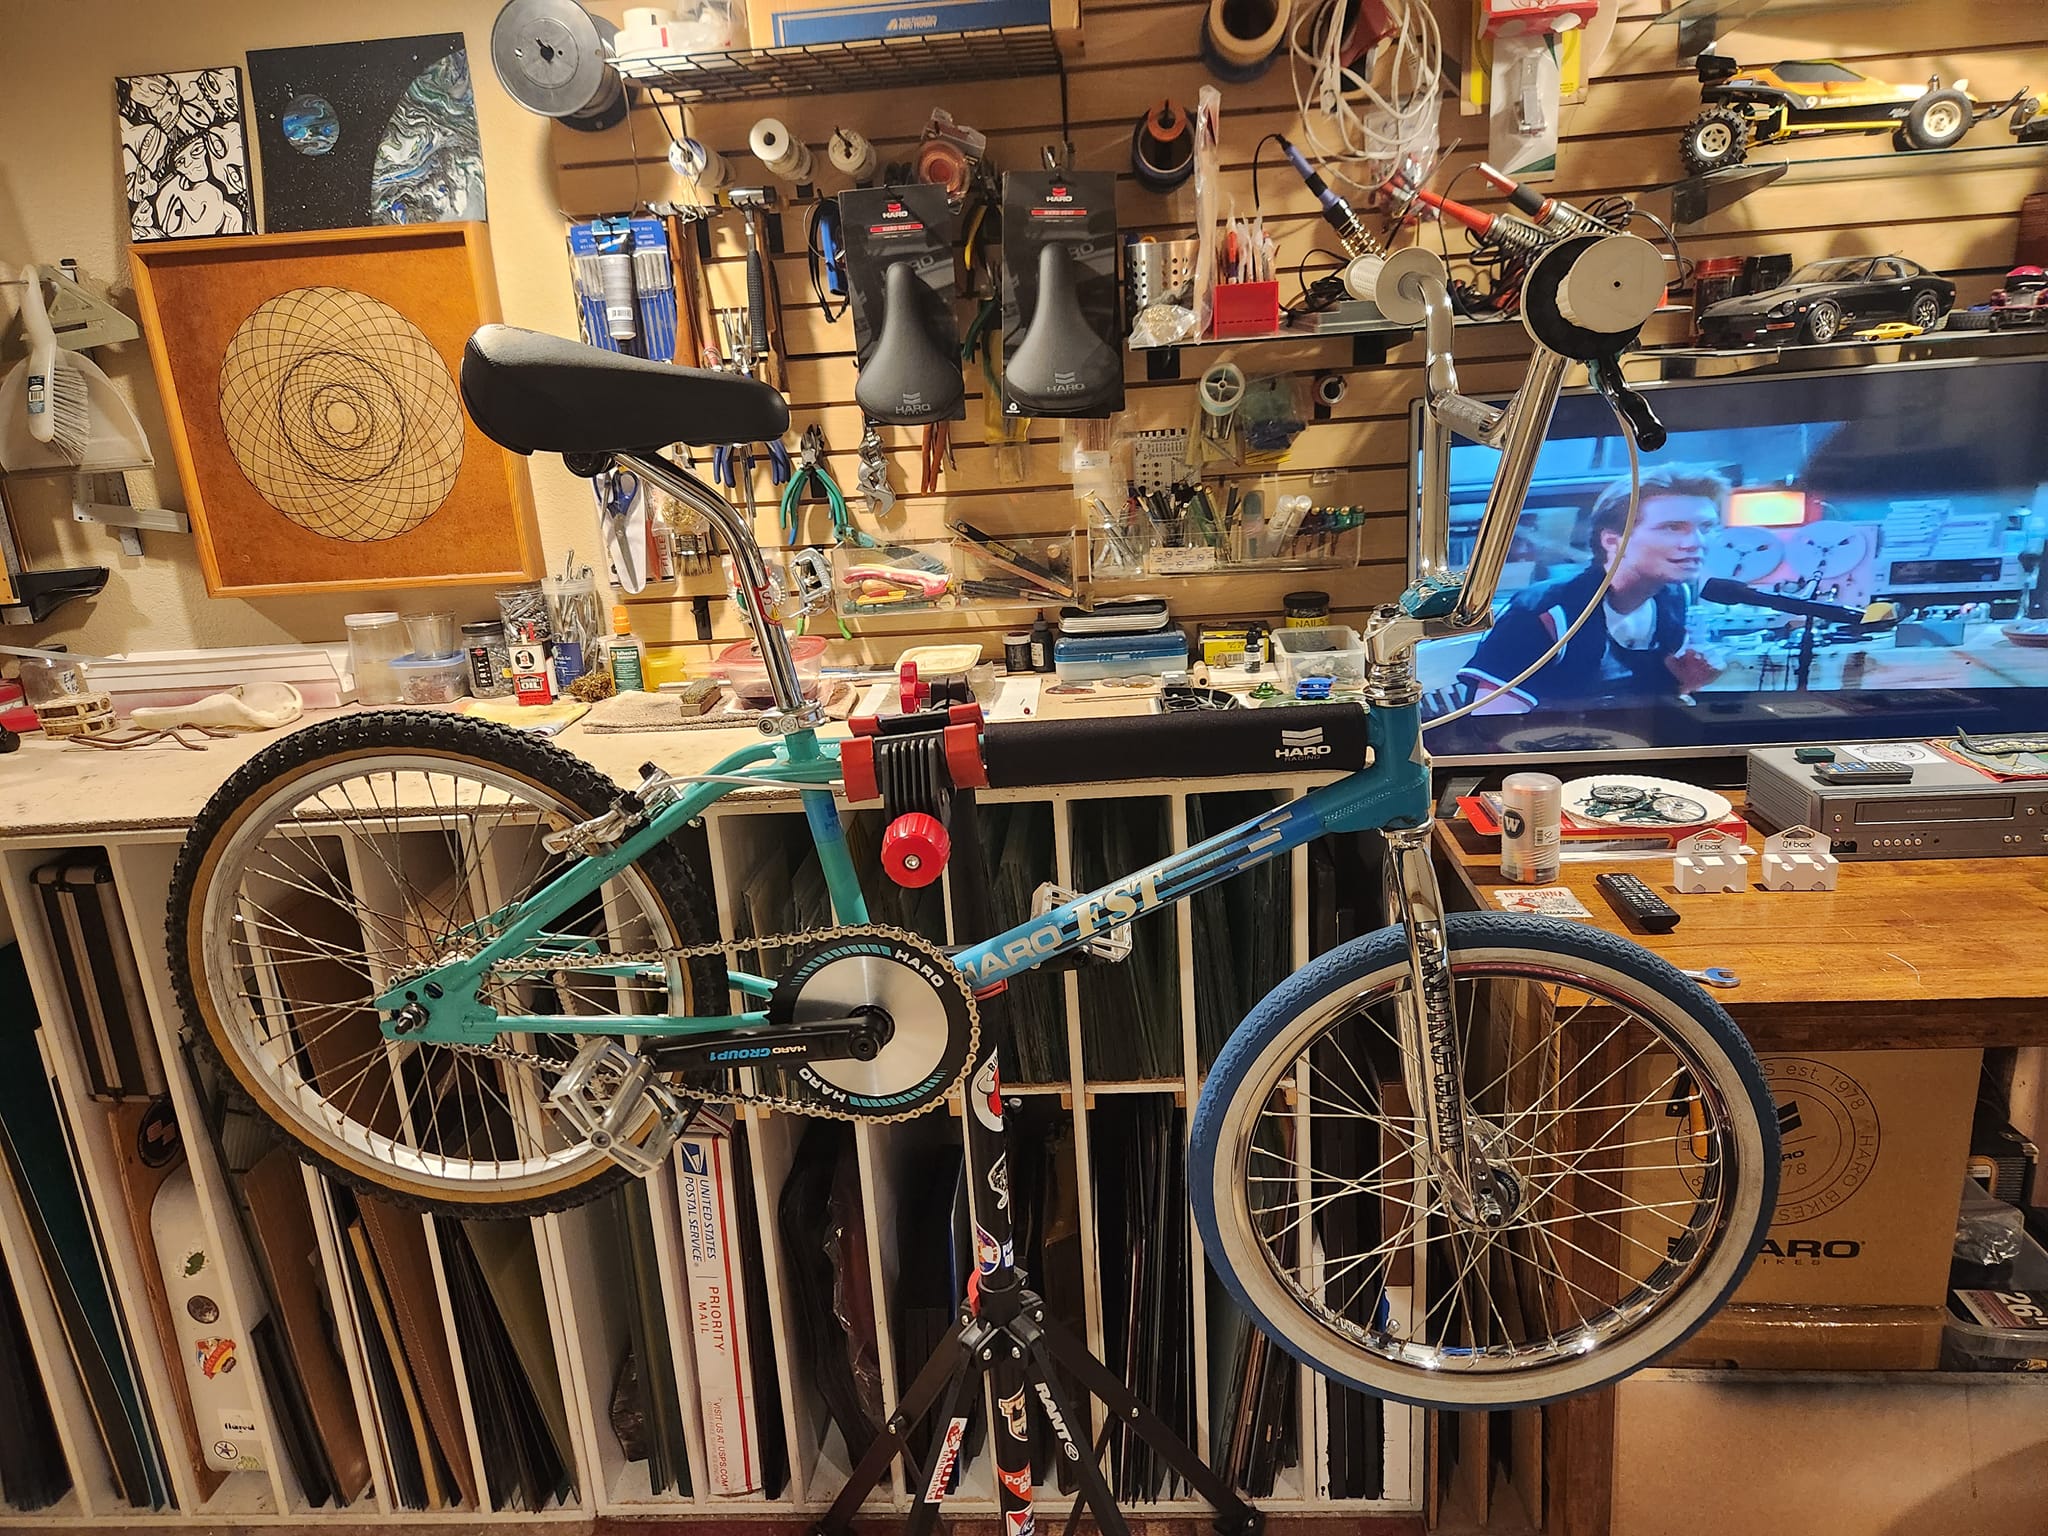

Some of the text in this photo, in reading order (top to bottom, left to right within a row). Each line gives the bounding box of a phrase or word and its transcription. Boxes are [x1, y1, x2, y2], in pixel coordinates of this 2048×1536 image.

[882, 210, 909, 219] HARO
[1047, 383, 1086, 392] HARO
[895, 403, 931, 414] HARO
[659, 535, 669, 567] FILLE
[521, 682, 541, 690] OIL
[1275, 745, 1332, 758] HARO
[1284, 754, 1321, 762] RACING
[1504, 815, 1520, 833] W
[1072, 869, 1164, 941] FST
[895, 949, 945, 988] HARO
[1415, 921, 1457, 1066] LANDING
[772, 1045, 807, 1055] HARO
[799, 1067, 847, 1103] HARO
[1433, 1073, 1464, 1154] GEAR
[1779, 1066, 1875, 1221] est. 1978 HARO BIKES
[1781, 1150, 1805, 1161] RO
[1784, 1162, 1808, 1177] 78
[684, 1177, 703, 1262] POSTAL SERVICE
[699, 1180, 717, 1259] UNITED STATES
[1757, 1239, 1861, 1259] ARO
[697, 1301, 709, 1333] MAIL
[708, 1286, 725, 1350] PRIORITY
[713, 1402, 722, 1421] VISIT
[1035, 1383, 1073, 1442] RANT
[715, 1423, 724, 1434] US
[717, 1435, 725, 1445] AT
